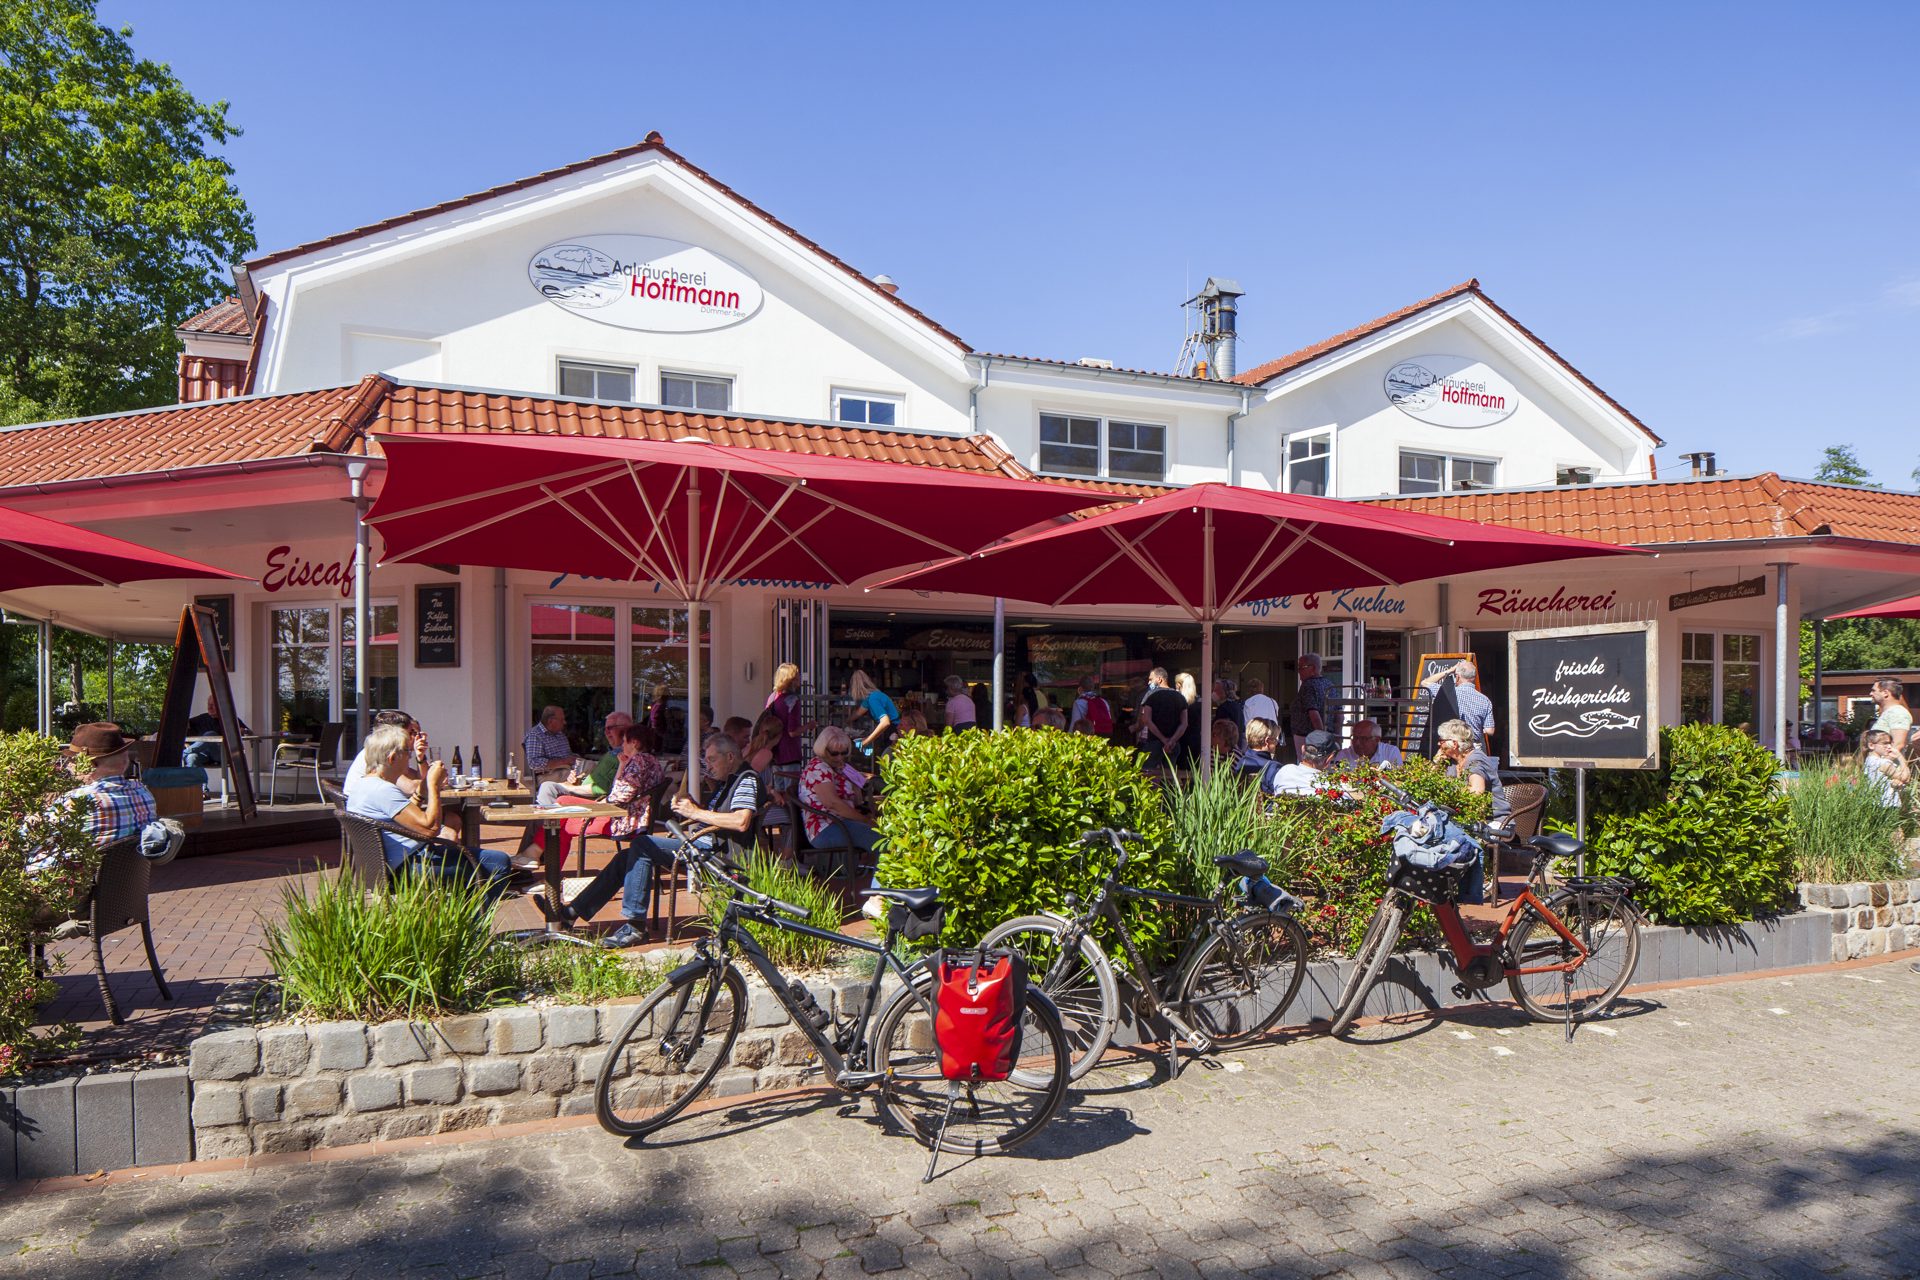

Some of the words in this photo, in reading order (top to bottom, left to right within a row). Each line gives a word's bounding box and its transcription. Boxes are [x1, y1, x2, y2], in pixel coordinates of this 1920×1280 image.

[612, 260, 707, 286] Aalräucherei
[631, 274, 740, 309] Hoffmann
[700, 306, 731, 316] Dümmer
[732, 309, 746, 318] See
[1431, 374, 1486, 392] Aalräucherei
[1441, 384, 1505, 409] Hoffmann
[263, 545, 372, 597] Eiscaf
[1303, 592, 1320, 610] &
[1331, 587, 1405, 613] Kuchen
[1476, 585, 1617, 616] Räucherei
[1708, 591, 1718, 602] Sie
[1737, 585, 1757, 596] Kasse
[845, 628, 874, 641] Softeis
[928, 629, 992, 648] Eiscreme
[1155, 636, 1193, 652] Kuchen
[1555, 656, 1605, 682] frische
[1532, 685, 1631, 709] Fischgerichte
